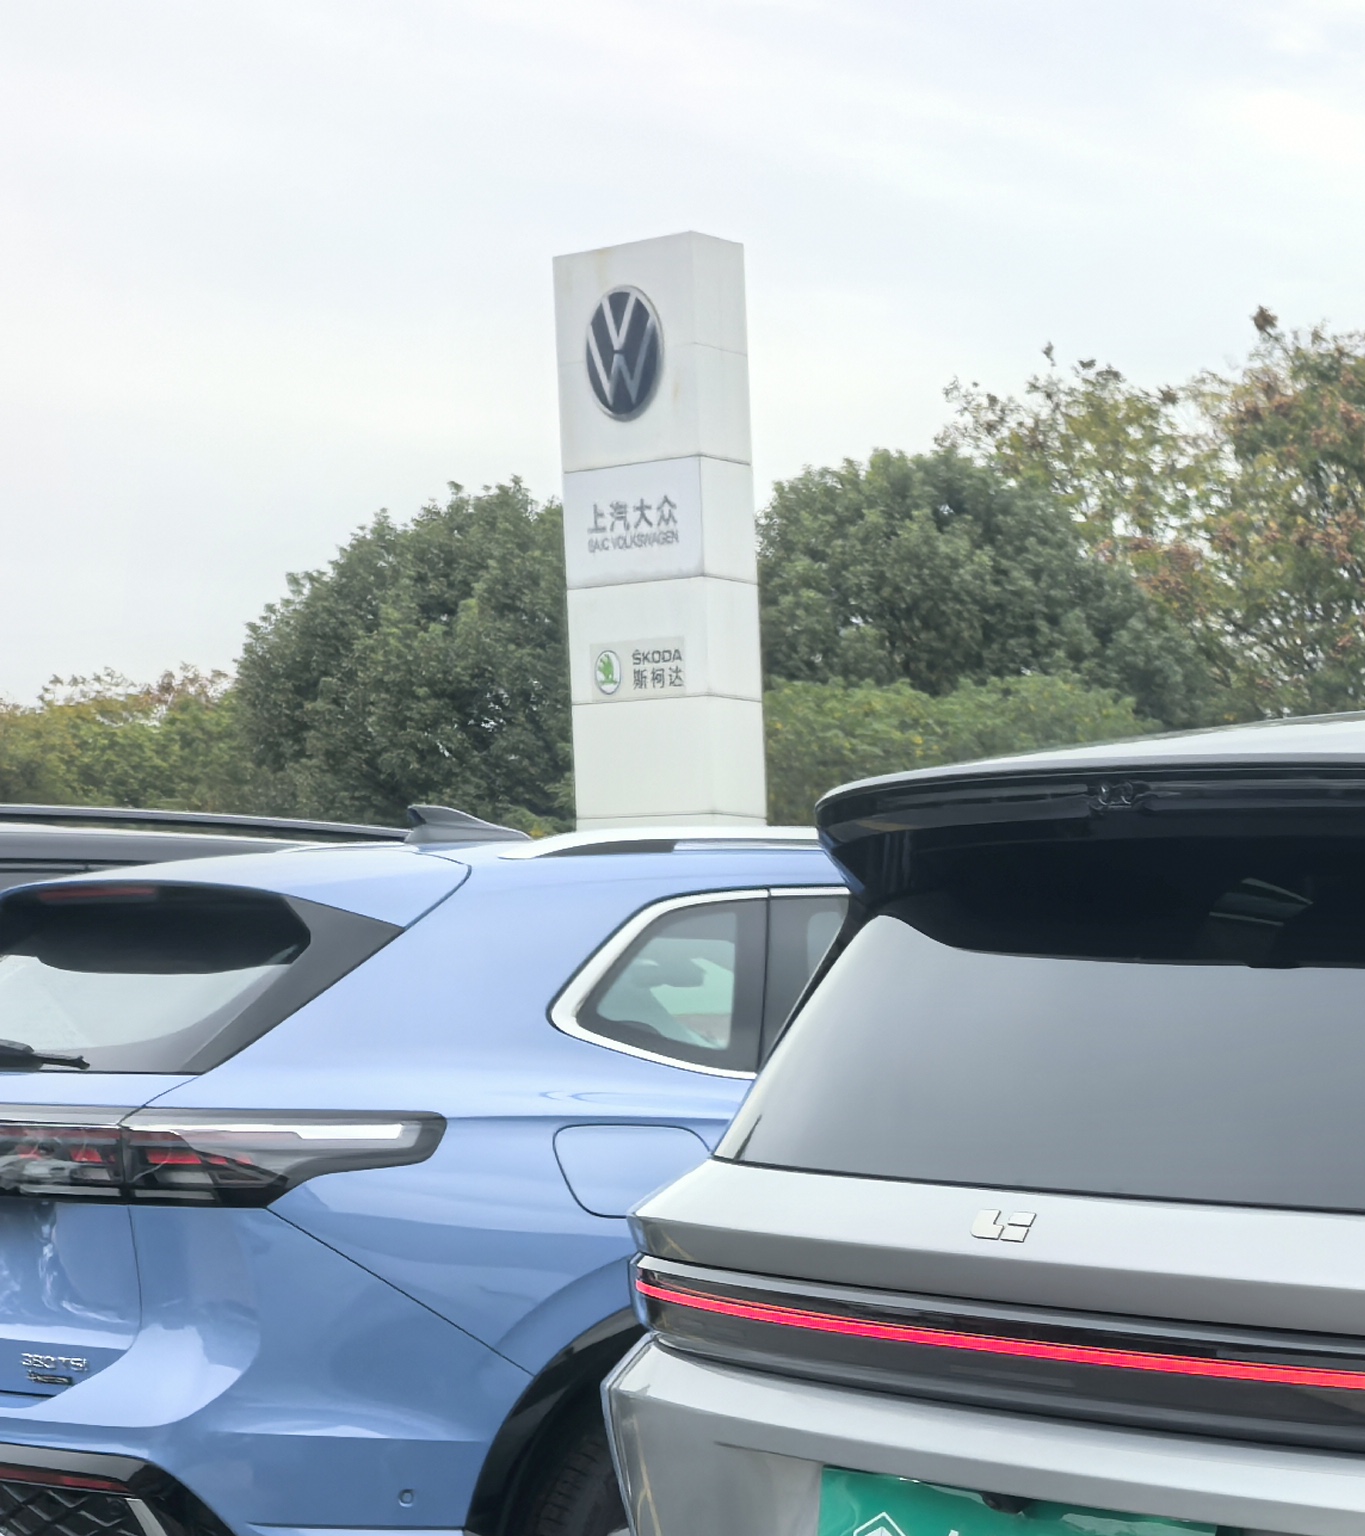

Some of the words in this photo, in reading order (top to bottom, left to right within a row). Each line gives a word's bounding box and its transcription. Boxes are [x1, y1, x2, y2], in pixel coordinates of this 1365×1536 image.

[587, 495, 678, 534] 上汽大众
[611, 530, 679, 550] VOLKSWAGEN
[633, 665, 684, 690] 斯柯达
